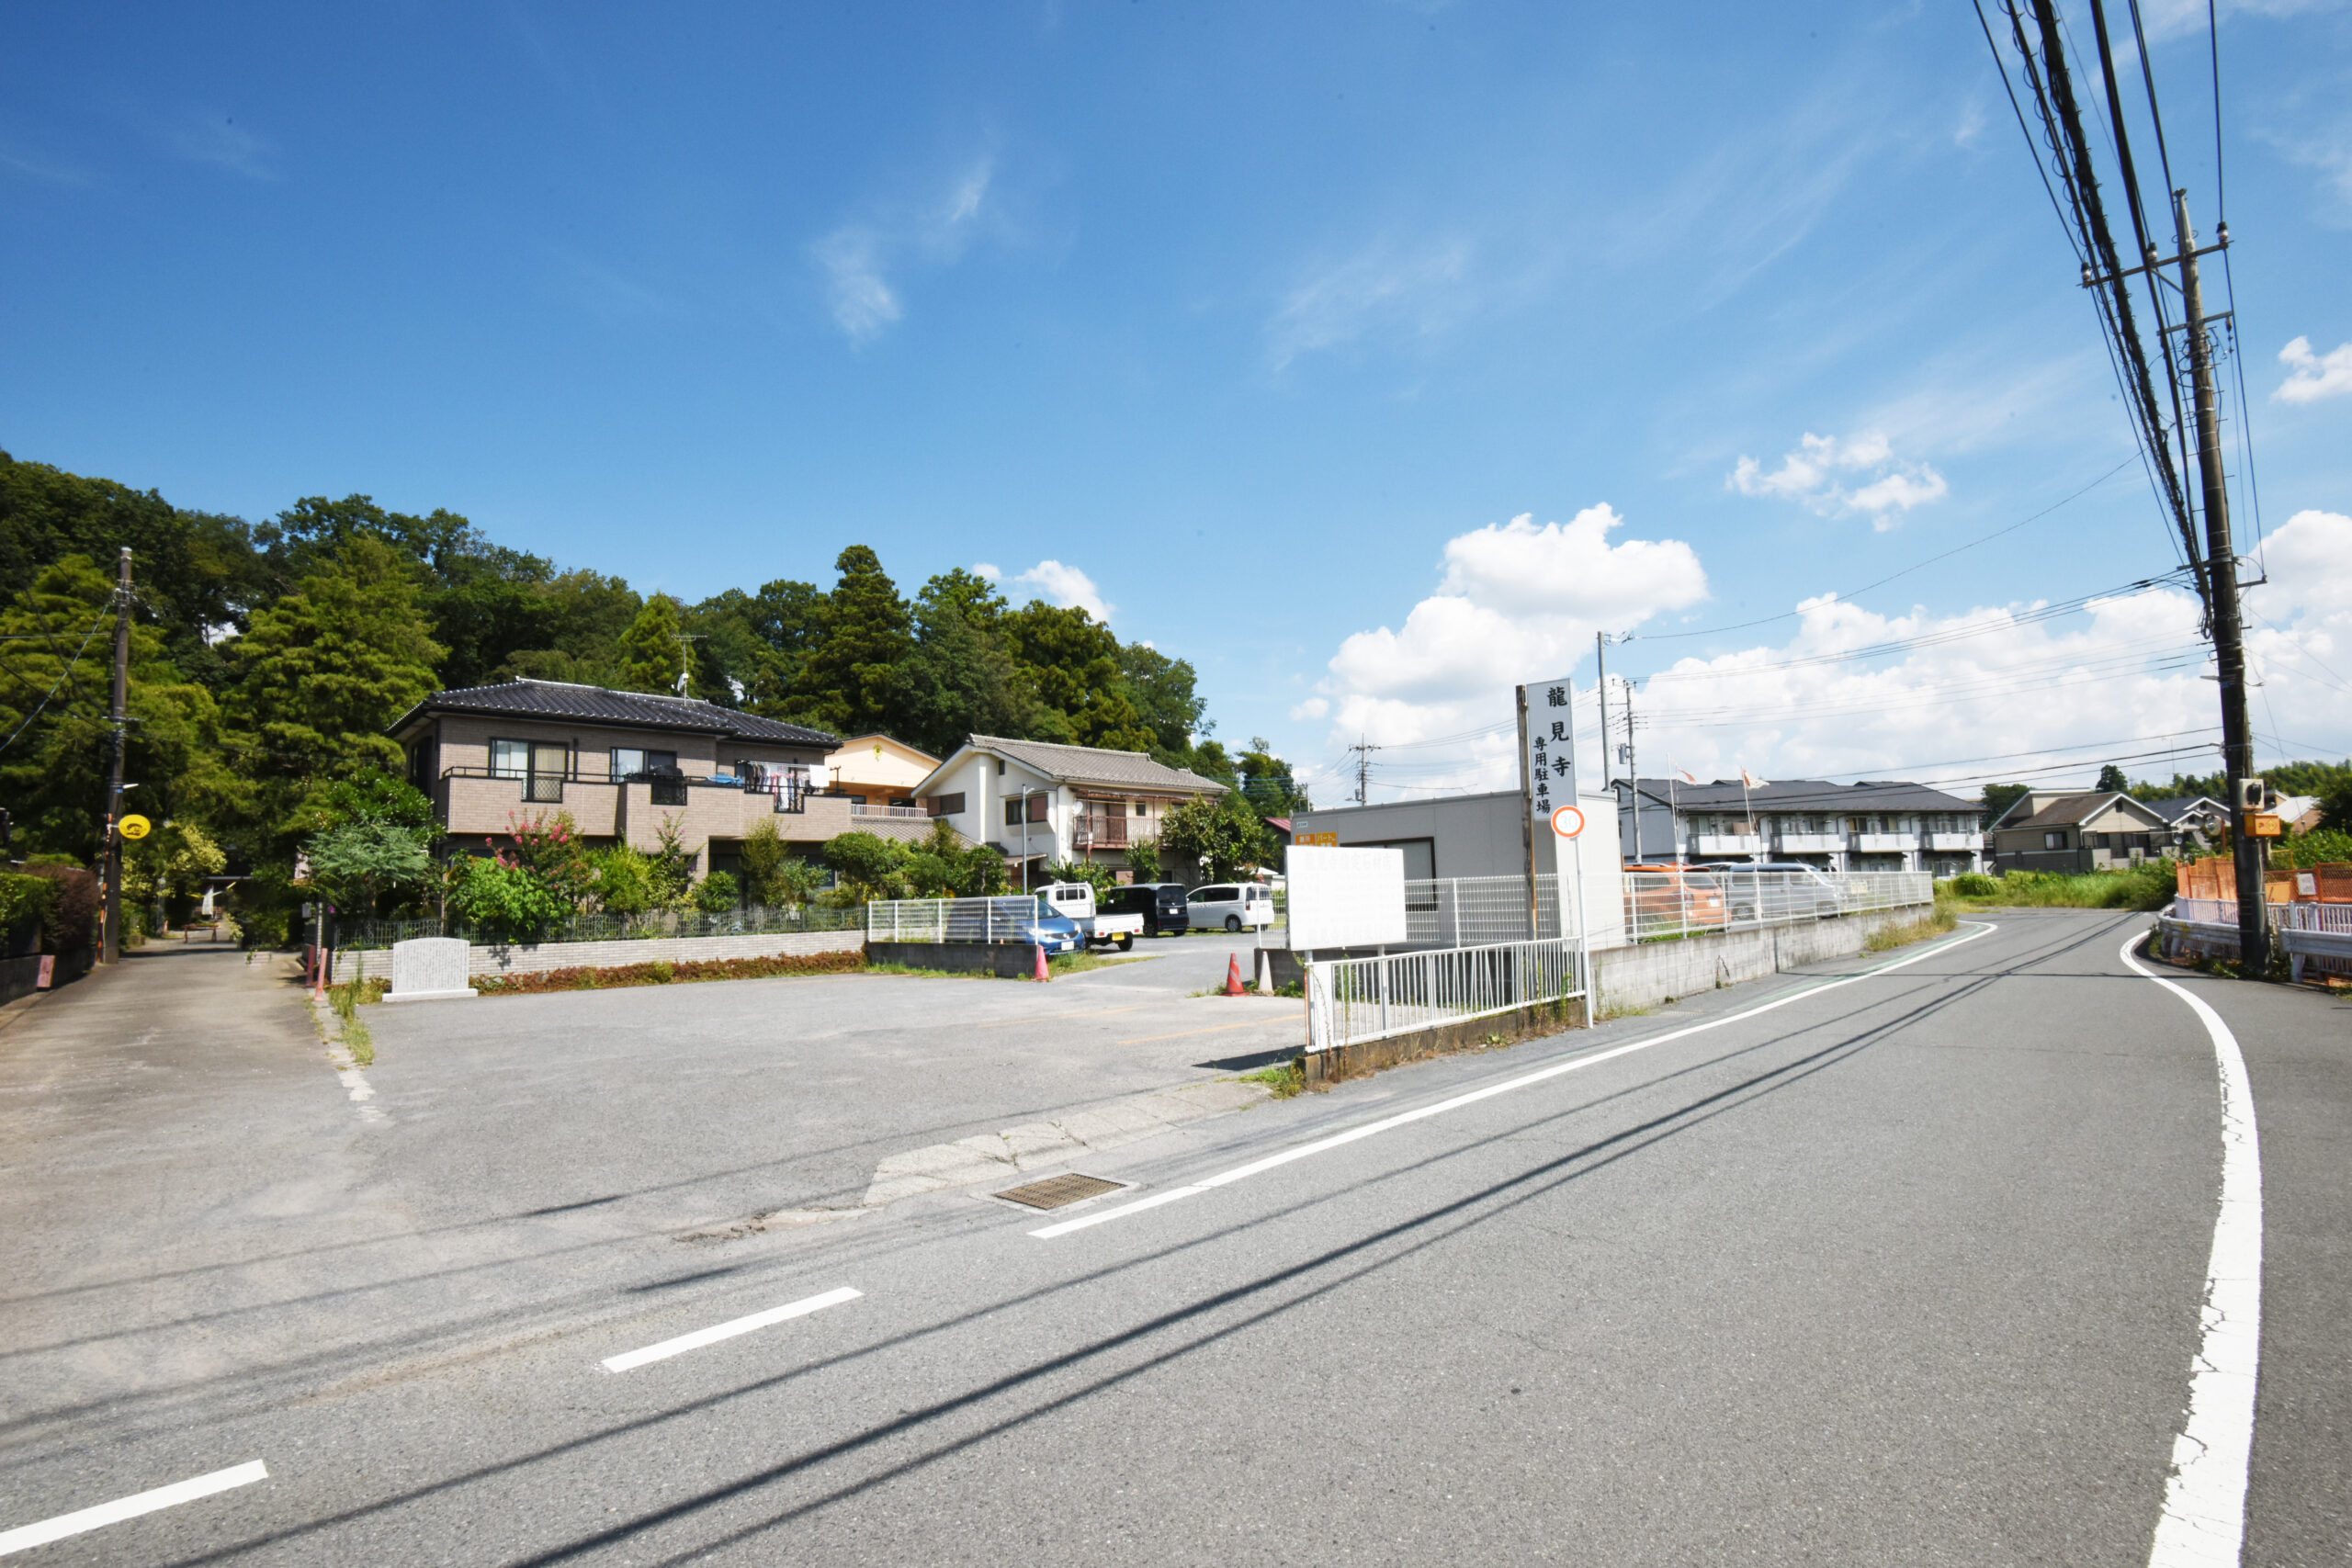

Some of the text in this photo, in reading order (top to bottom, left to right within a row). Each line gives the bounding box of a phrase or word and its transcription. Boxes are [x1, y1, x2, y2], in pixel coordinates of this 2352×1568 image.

[1547, 686, 1571, 777] 龍見寺
[1533, 736, 1551, 815] 専用駐車場
[1560, 815, 1577, 829] 30
